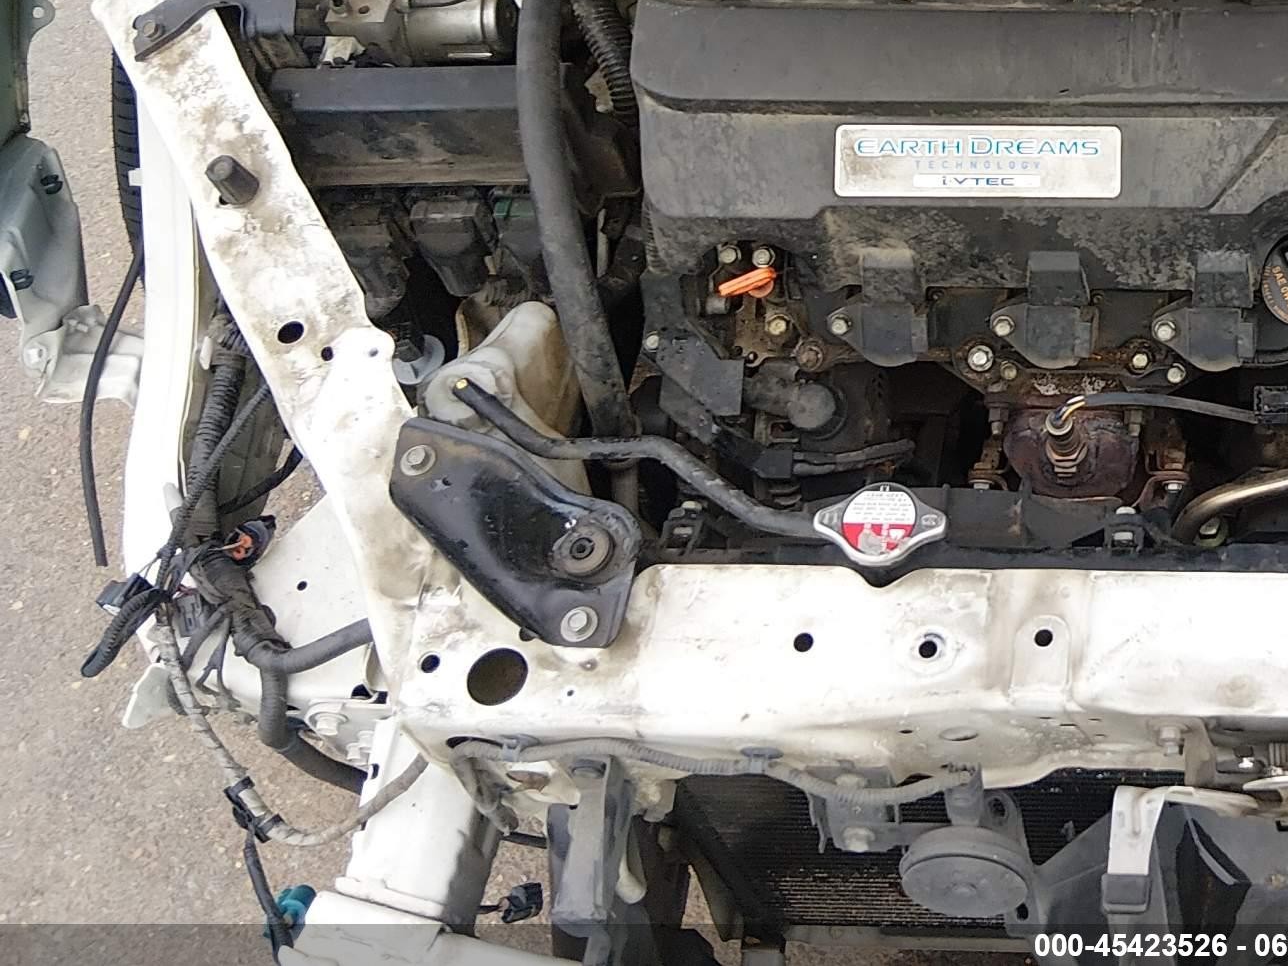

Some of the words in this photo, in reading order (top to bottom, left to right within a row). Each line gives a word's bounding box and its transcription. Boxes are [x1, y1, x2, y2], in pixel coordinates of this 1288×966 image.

[857, 137, 961, 156] EARTH
[970, 136, 1100, 157] DREAMS
[915, 160, 1042, 170] TECHNOLOGY
[1271, 265, 1286, 288] SAE
